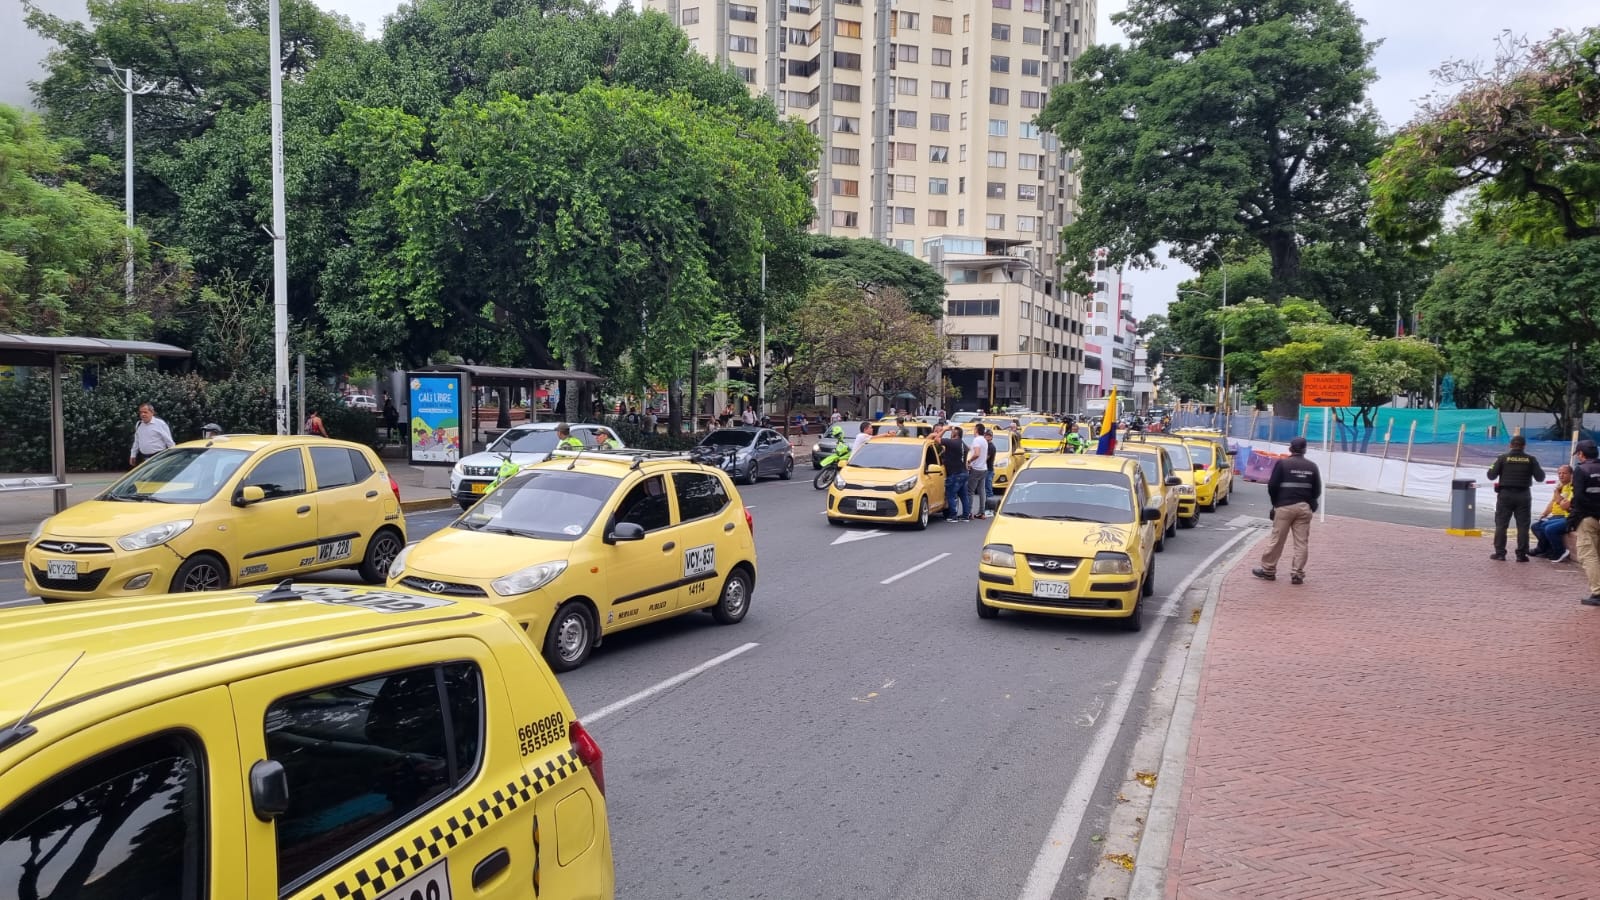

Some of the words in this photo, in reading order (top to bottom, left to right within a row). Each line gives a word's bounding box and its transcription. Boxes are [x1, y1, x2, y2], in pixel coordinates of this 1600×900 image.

[434, 392, 452, 403] LIBRE
[319, 544, 334, 560] VCY
[336, 540, 350, 556] 228
[685, 547, 715, 570] VCY-837
[689, 582, 705, 596] 14114
[518, 711, 564, 742] 6606060
[520, 724, 566, 757] 5555555
